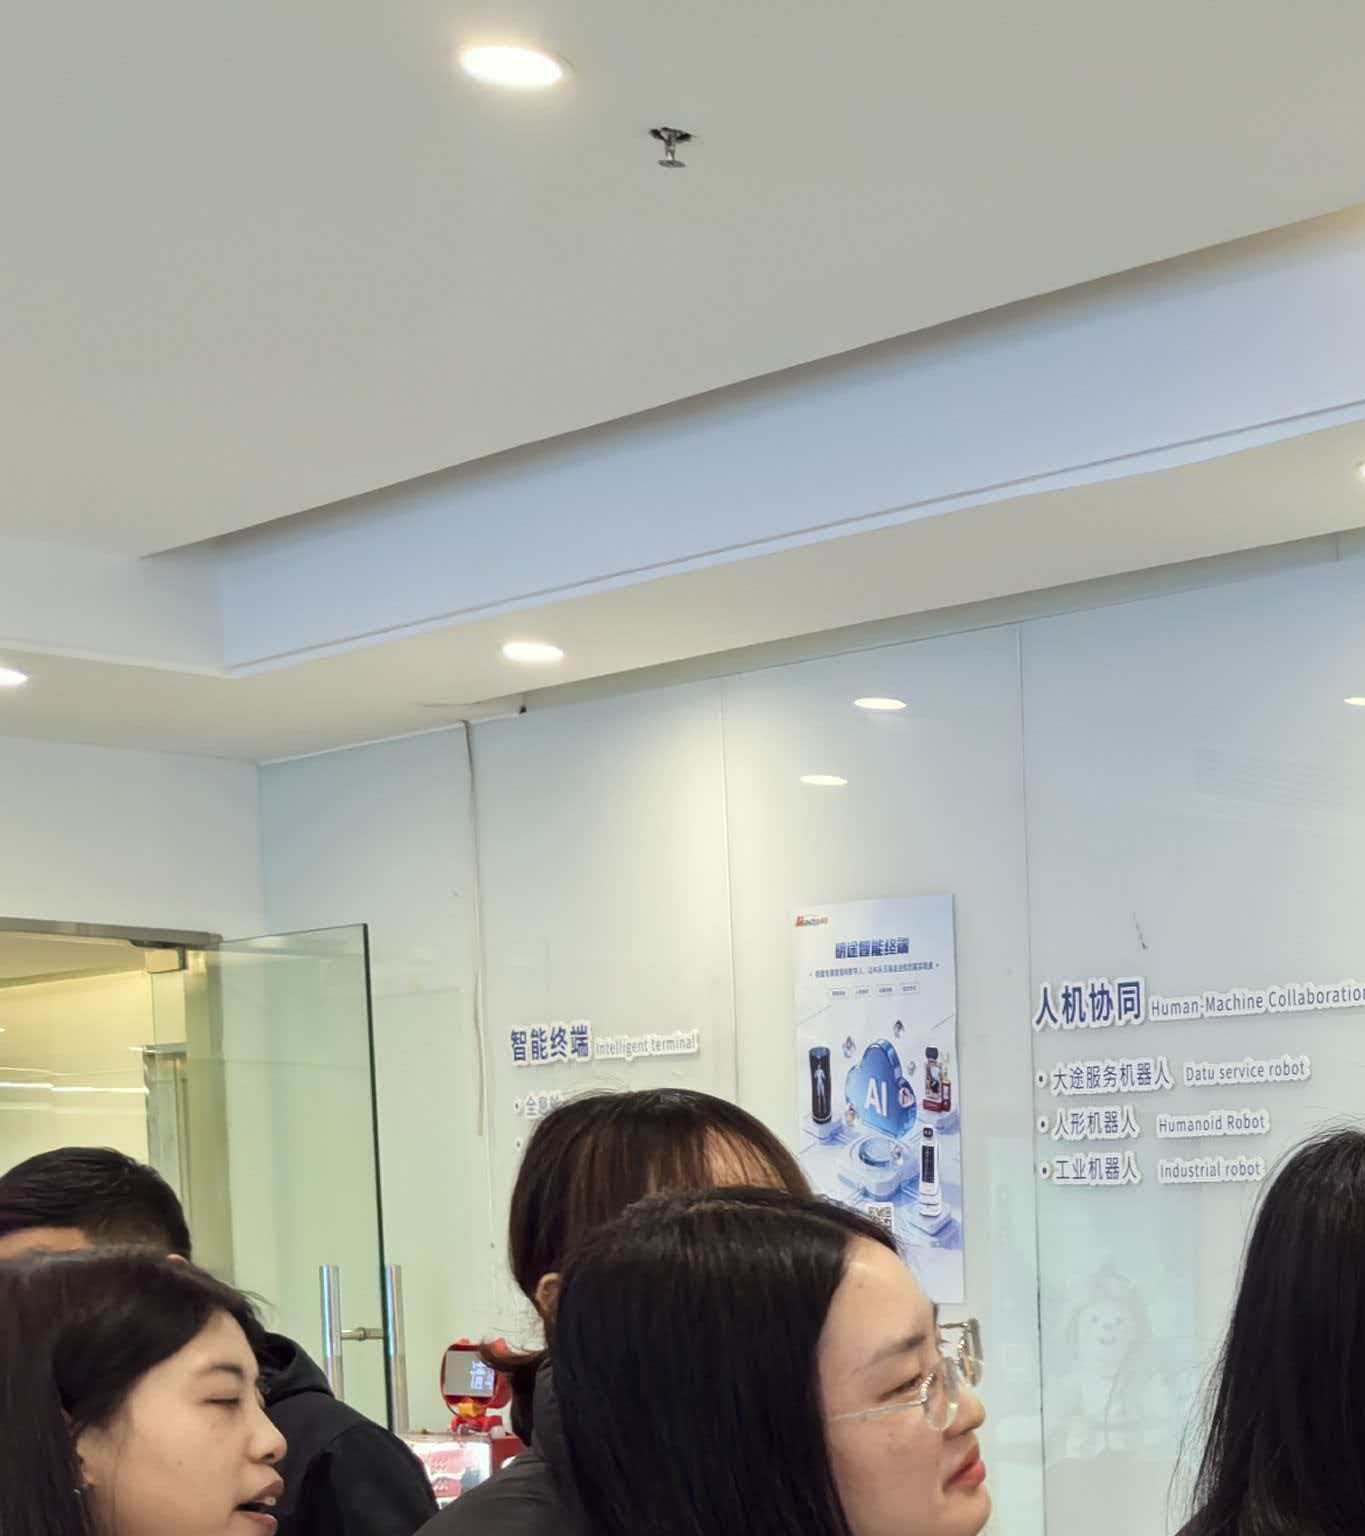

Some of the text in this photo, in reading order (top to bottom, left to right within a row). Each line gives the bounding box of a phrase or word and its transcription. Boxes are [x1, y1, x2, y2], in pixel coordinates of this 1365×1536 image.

[1035, 981, 1141, 1026] 人机协同
[1151, 993, 1264, 1017] Human-Machine
[510, 1023, 589, 1062] 智能终端
[651, 1033, 696, 1052] terminal
[1052, 1061, 1170, 1092] 大途服务机器人
[1185, 1058, 1306, 1082] Datu service robot
[863, 1077, 888, 1117] AI
[1054, 1110, 1137, 1136] 人形机器人
[1159, 1112, 1265, 1134] Humanoid Robot
[1056, 1156, 1138, 1180] 工业机器人
[1159, 1159, 1261, 1179] Industrial robot
